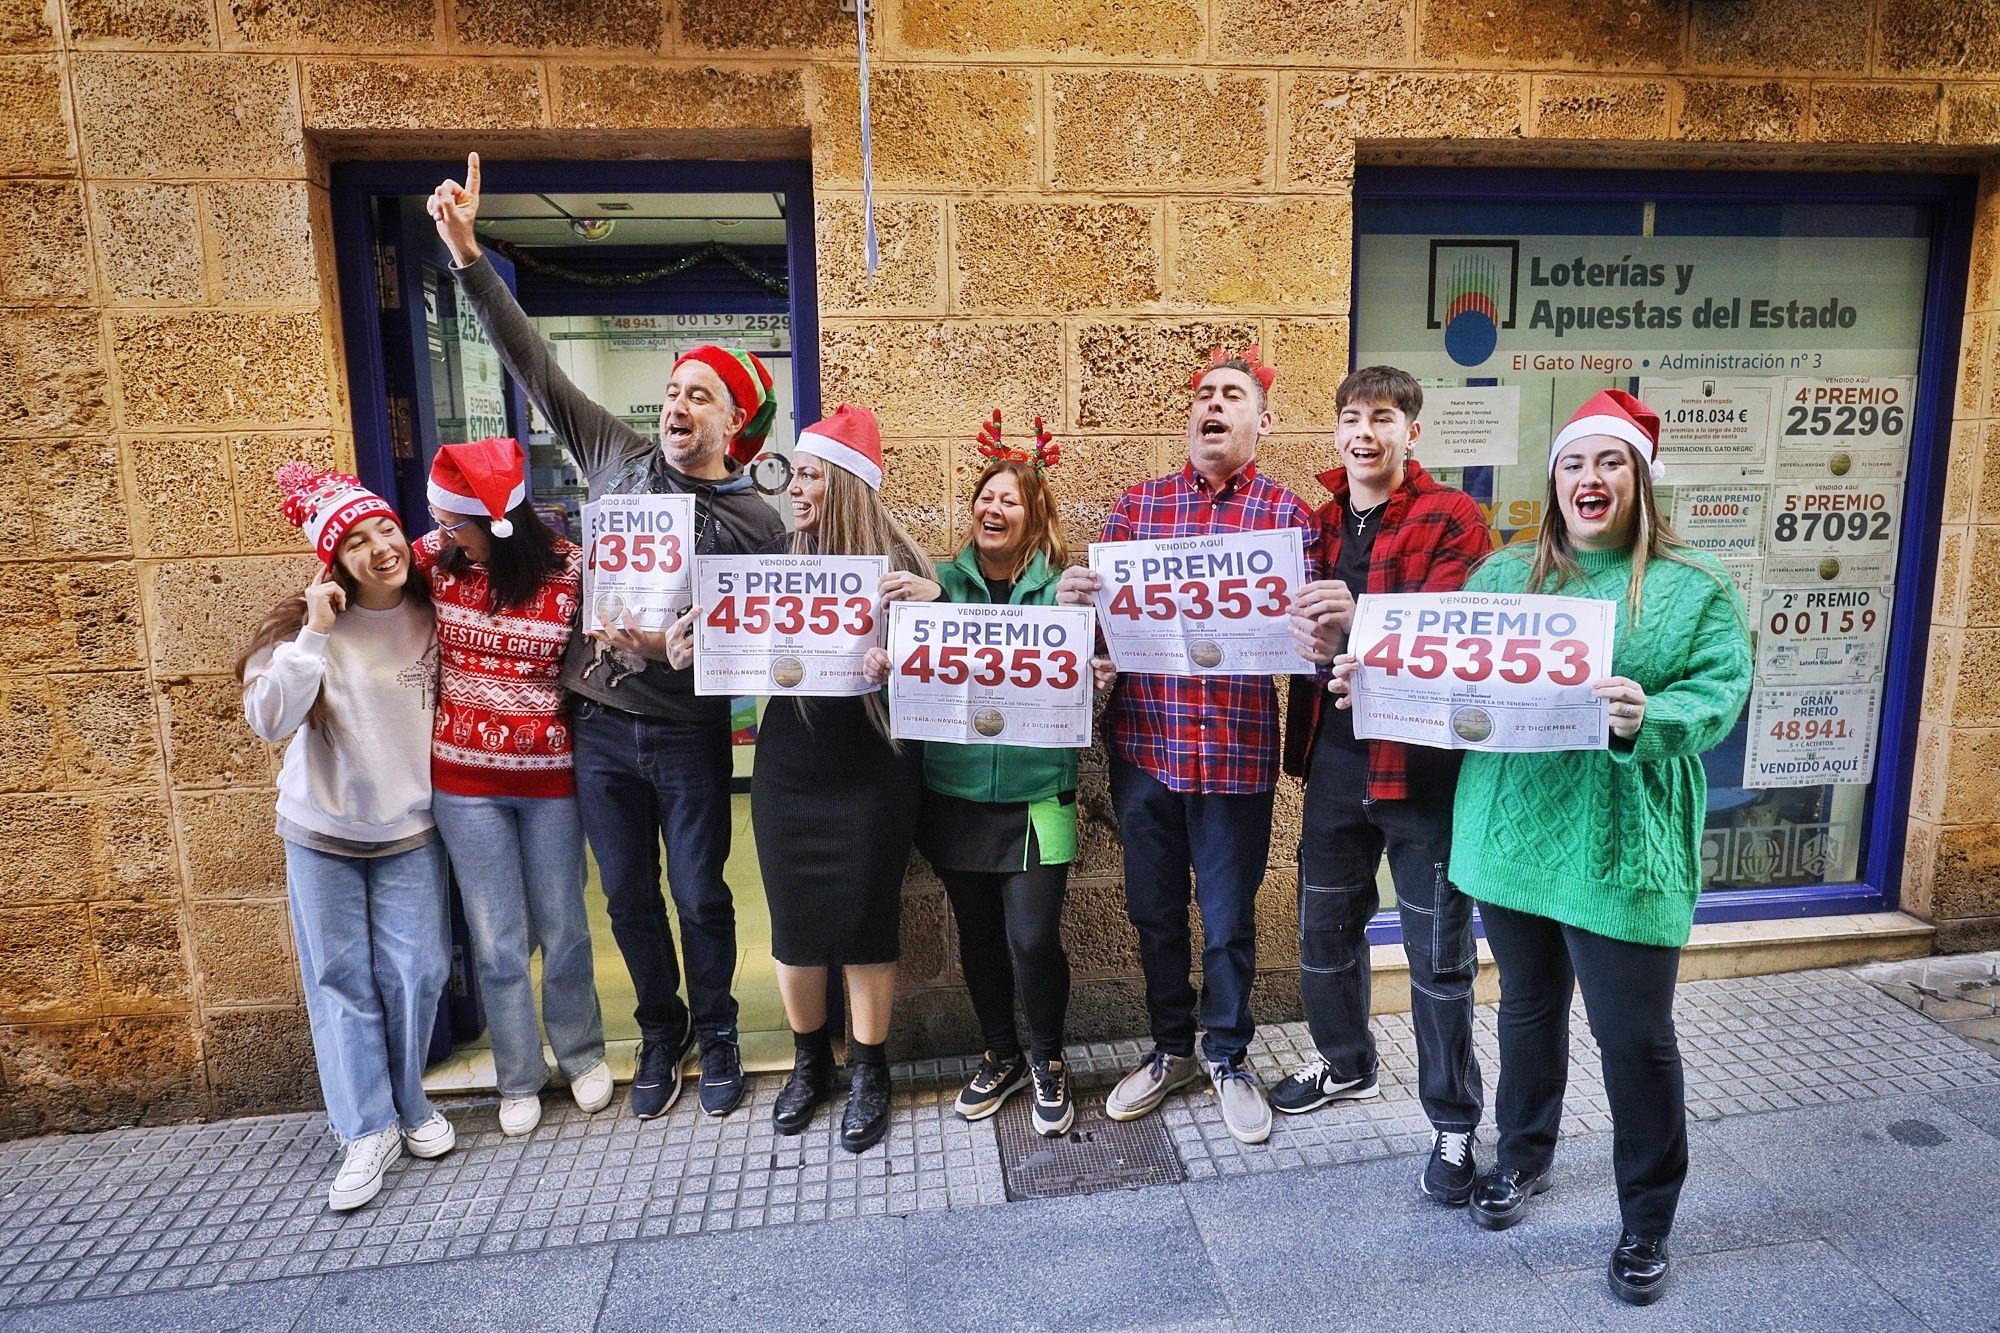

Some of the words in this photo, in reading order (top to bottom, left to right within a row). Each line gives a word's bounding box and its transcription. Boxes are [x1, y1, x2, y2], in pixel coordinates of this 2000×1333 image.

[1531, 254, 1665, 287] Loterías
[1674, 264, 1695, 295] y
[744, 315, 791, 330] 2529
[1529, 299, 1683, 338] Apuestas
[1692, 297, 1741, 329] del
[1750, 297, 1857, 330] Estado
[648, 337, 666, 346] AQUÍ
[1512, 355, 1528, 371] El
[1532, 355, 1575, 371] Gato
[1581, 355, 1633, 374] Negro
[1659, 353, 1785, 371] Administración
[1790, 353, 1809, 369] nº
[1813, 353, 1822, 369] 3
[1795, 387, 1811, 404] 4º
[1815, 387, 1899, 405] PREMIO
[1664, 409, 1734, 423] 1.018.034
[1738, 409, 1748, 423] €
[1784, 405, 1904, 436] 25296
[621, 497, 640, 506] AQUÍ
[1696, 495, 1722, 503] GRAN
[1724, 494, 1762, 503] PREMIO
[1784, 494, 1801, 511] 5º
[1804, 493, 1885, 511] PREMIO
[1691, 504, 1739, 517] 10.000
[1742, 506, 1750, 516] €
[322, 521, 343, 551] OH
[339, 498, 392, 524] DEER
[598, 511, 674, 533] REMIO
[1774, 511, 1891, 542] 87092
[1154, 541, 1197, 552] VENDIDO
[1199, 537, 1224, 548] AQUÍ
[1685, 539, 1726, 548] ENDIDO
[1729, 536, 1756, 549] AQUÍ
[759, 559, 798, 567] VENDIDO
[800, 558, 822, 567] AQUÍ
[1114, 559, 1136, 584] 5º
[1142, 549, 1273, 582] PREMIO
[746, 572, 862, 595] PREMIO
[1109, 575, 1292, 621] 45353
[1439, 596, 1490, 606] VENDIDO
[1492, 597, 1522, 606] AQUÍ
[1782, 593, 1798, 609] 2º
[1806, 591, 1870, 608] PREMIO
[706, 595, 874, 636] 45353
[957, 608, 998, 617] VENDIDO
[1000, 608, 1024, 617] AQUÍ
[1382, 609, 1411, 631] 5º
[1417, 609, 1577, 637] PREMIO
[1770, 609, 1876, 635] 00159
[443, 625, 504, 650] FESTIVE
[507, 637, 554, 656] CREW
[912, 619, 936, 643] 5º
[941, 620, 1067, 648] PREMIO
[900, 644, 1079, 690] 45353
[1363, 633, 1591, 687] 45353
[706, 668, 733, 676] LOTERÍA
[1800, 696, 1833, 706] GRAN
[1368, 711, 1400, 721] LOTERÍA
[1408, 716, 1445, 727] NAVIDAD
[1793, 706, 1838, 717] PREMIO
[937, 717, 967, 725] NAVIDAD
[1528, 724, 1577, 732] DICIEMBRE
[1769, 719, 1847, 740] 48.941
[1760, 761, 1820, 774] VENDIDO
[1823, 756, 1858, 774] AQUÍ
